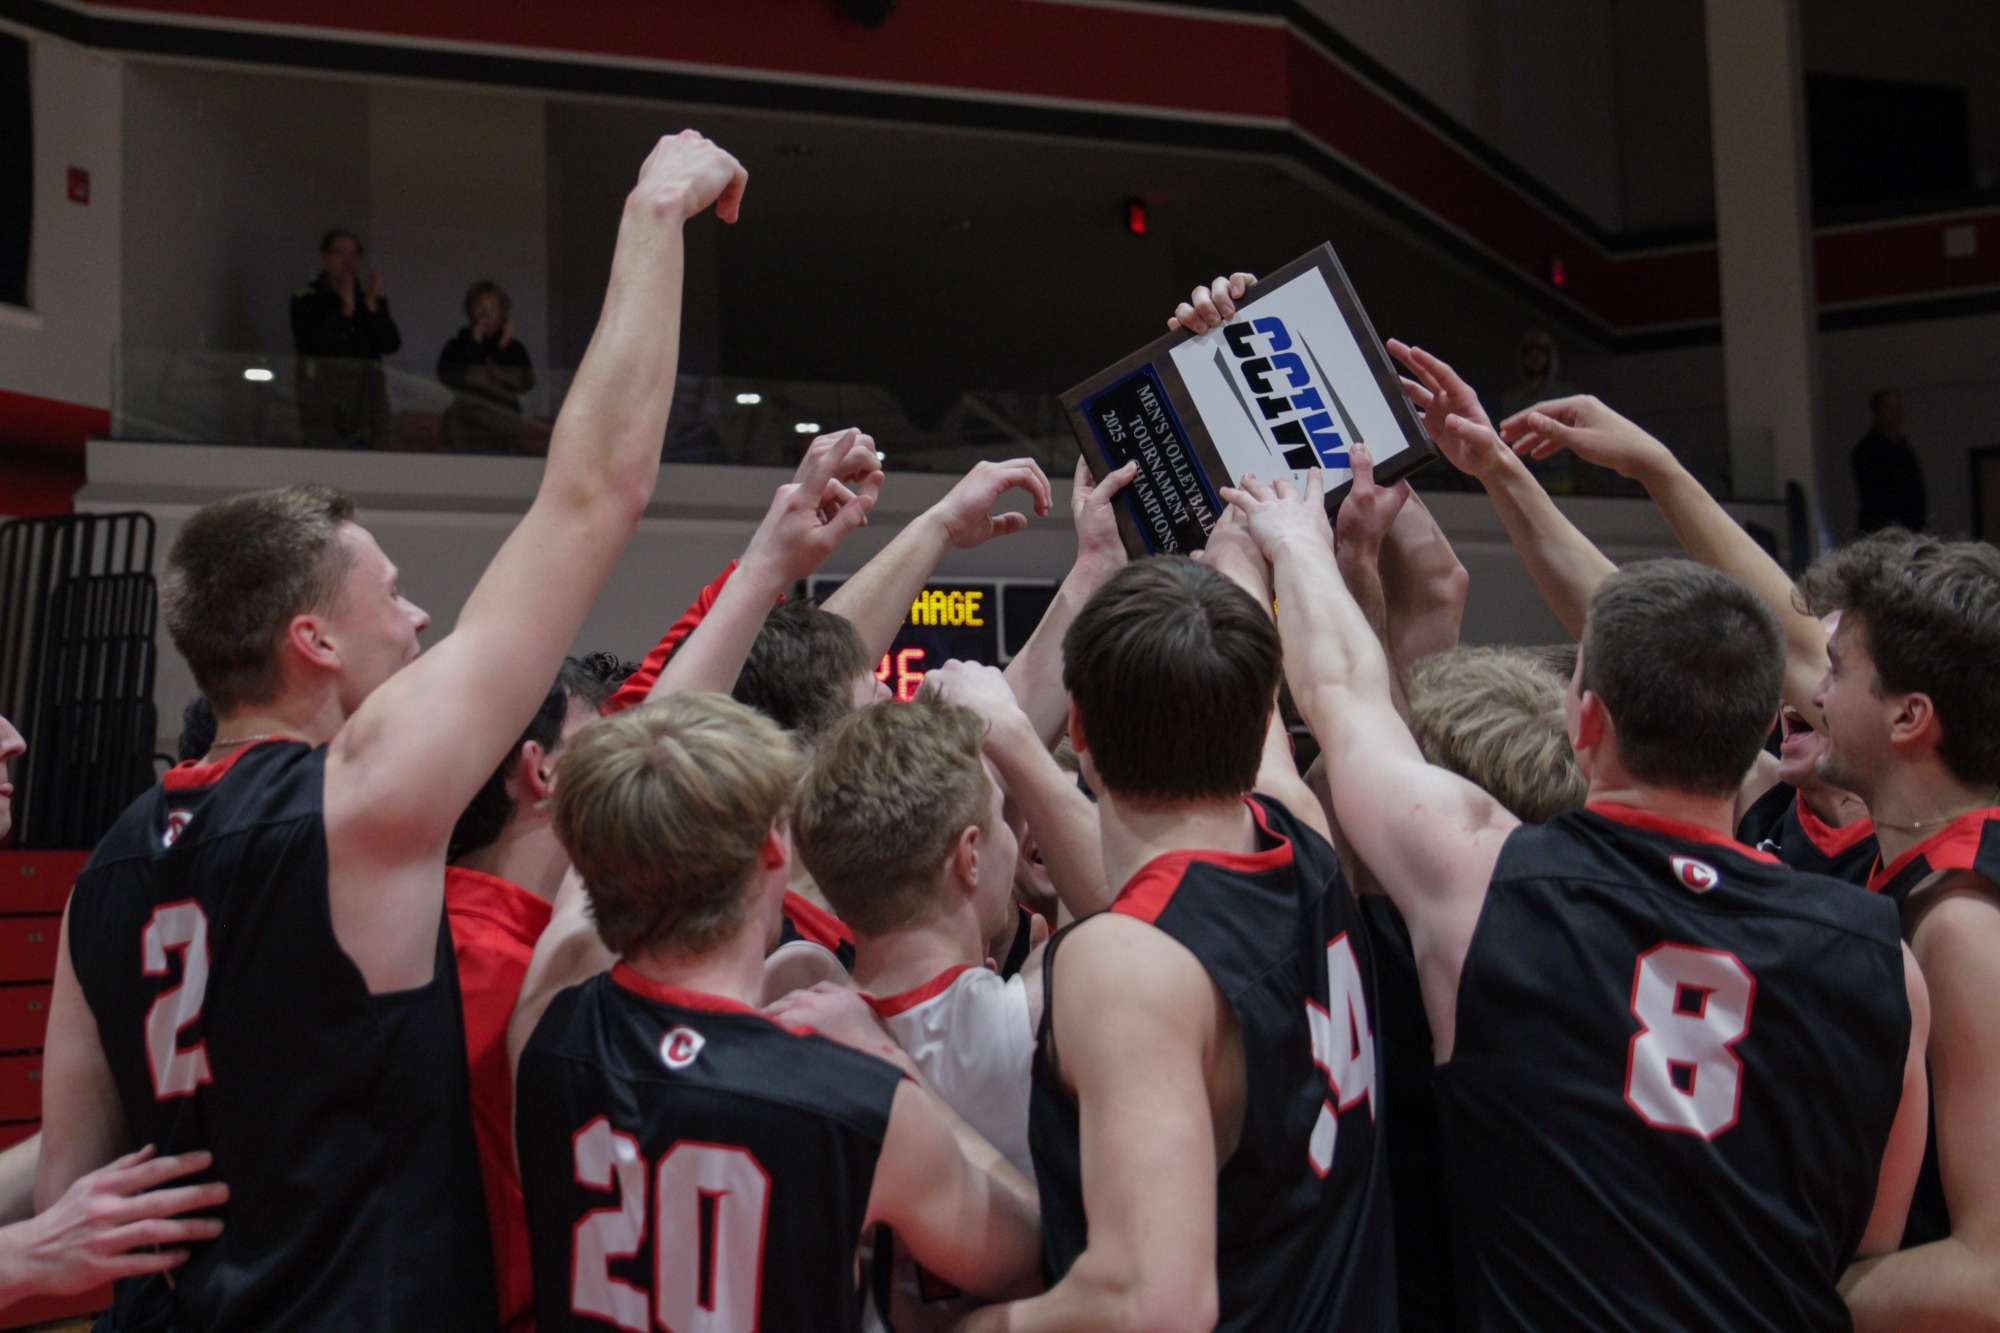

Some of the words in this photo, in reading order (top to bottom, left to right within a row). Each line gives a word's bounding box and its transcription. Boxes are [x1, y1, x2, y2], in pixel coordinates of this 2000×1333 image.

[1101, 409, 1127, 443] 2025
[1129, 414, 1190, 525] TOURNAMENT
[1136, 384, 1170, 435] MEN'S
[1161, 432, 1217, 537] VOLLEYBALL
[1223, 316, 1351, 470] CCIW
[910, 590, 984, 627] HAGE
[141, 898, 213, 1103] 2
[1623, 940, 1757, 1142] 8
[571, 1113, 771, 1333] 20
